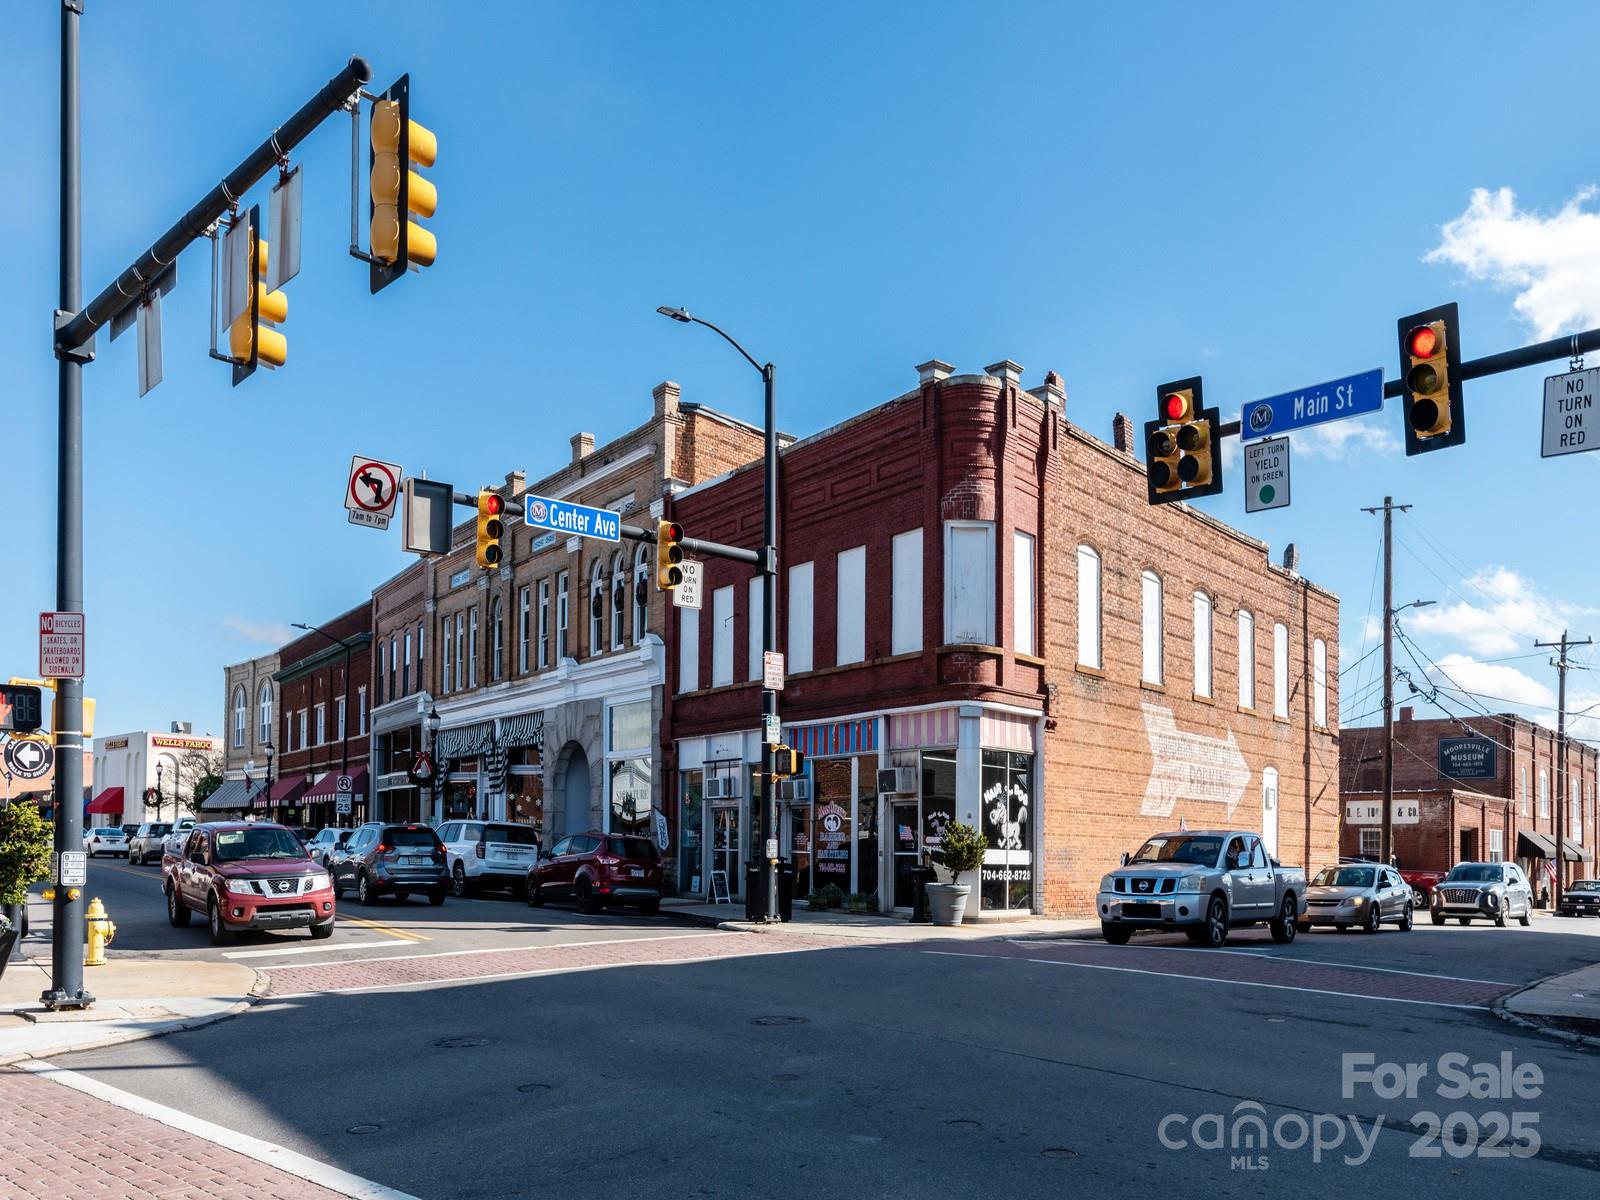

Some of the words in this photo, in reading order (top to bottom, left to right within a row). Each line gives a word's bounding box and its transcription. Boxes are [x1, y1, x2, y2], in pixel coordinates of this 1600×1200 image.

[1566, 378, 1584, 395] NO
[1293, 391, 1329, 420] Main
[1335, 383, 1354, 410] St
[1558, 394, 1592, 413] TURN
[1565, 413, 1583, 429] ON
[1560, 430, 1586, 448] RED
[1249, 447, 1265, 459] LEFT
[1267, 443, 1285, 455] TURN
[1255, 456, 1280, 471] YIELD
[1251, 475, 1260, 484] ON
[1262, 471, 1284, 482] GREEN
[352, 510, 365, 521] 7am
[366, 514, 373, 522] to
[374, 514, 387, 526] 7pm
[549, 503, 590, 533] Center
[594, 512, 616, 538] Ave
[682, 564, 695, 575] NO
[683, 576, 697, 585] URN
[683, 585, 693, 593] ON
[681, 594, 694, 604] RED
[41, 616, 53, 632] NO
[55, 620, 81, 628] BICYCLES
[70, 636, 78, 644] OR
[43, 647, 81, 655] SKATEBOARDS
[44, 656, 70, 665] ALLOWED
[71, 656, 80, 664] ON
[48, 665, 75, 674] SIDEWALK
[155, 738, 184, 746] WELLS
[185, 741, 212, 749] FARGO
[1443, 743, 1490, 756] MOORESVILLE
[1450, 753, 1485, 761] MUSEUM
[7, 760, 24, 777] WALK
[32, 762, 51, 778] SHOPS
[983, 782, 1002, 804] HAIR
[1013, 783, 1028, 806] DOG
[337, 803, 350, 811] 25
[1397, 807, 1403, 817] &
[982, 869, 1031, 881] 704-662-8728
